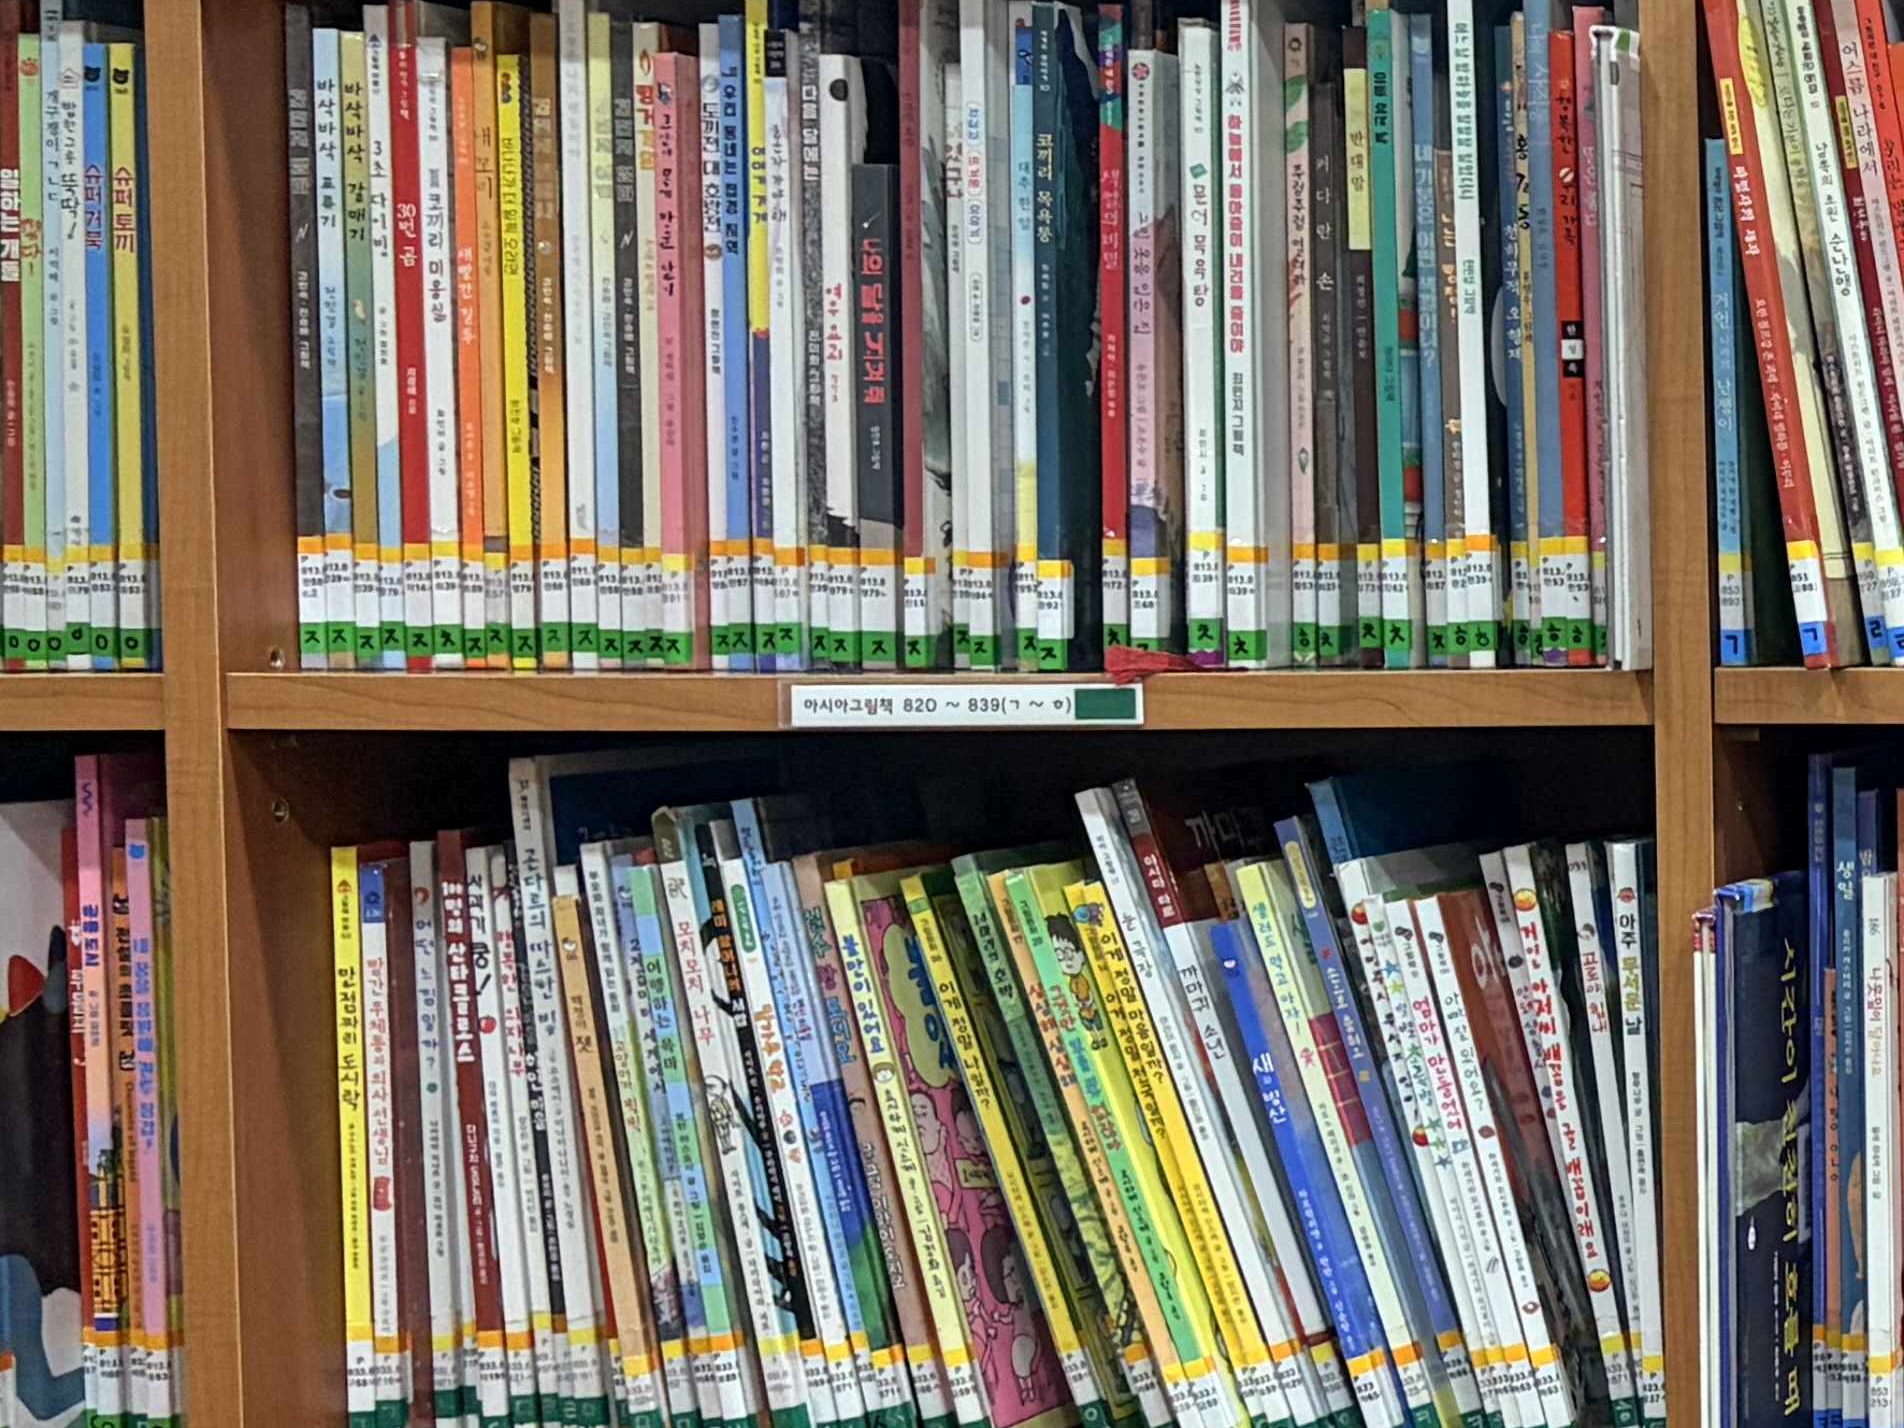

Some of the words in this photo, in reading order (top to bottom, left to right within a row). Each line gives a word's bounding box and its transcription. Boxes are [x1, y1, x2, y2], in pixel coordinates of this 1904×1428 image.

[317, 79, 336, 161] 바삭바삭
[86, 211, 103, 251] 거북
[427, 193, 445, 250] 코끼리
[803, 696, 894, 714] 아시아그림책
[903, 696, 937, 712] 820
[1836, 861, 1856, 900] 생일
[1618, 913, 1637, 948] 아주
[337, 968, 358, 1045] 만점짜리
[677, 921, 705, 994] 모치모치
[692, 1005, 715, 1045] 나무
[1621, 957, 1641, 1011] 무서운
[1203, 1022, 1229, 1060] 소년
[1624, 1016, 1642, 1037] 날
[339, 1053, 360, 1111] 도시락
